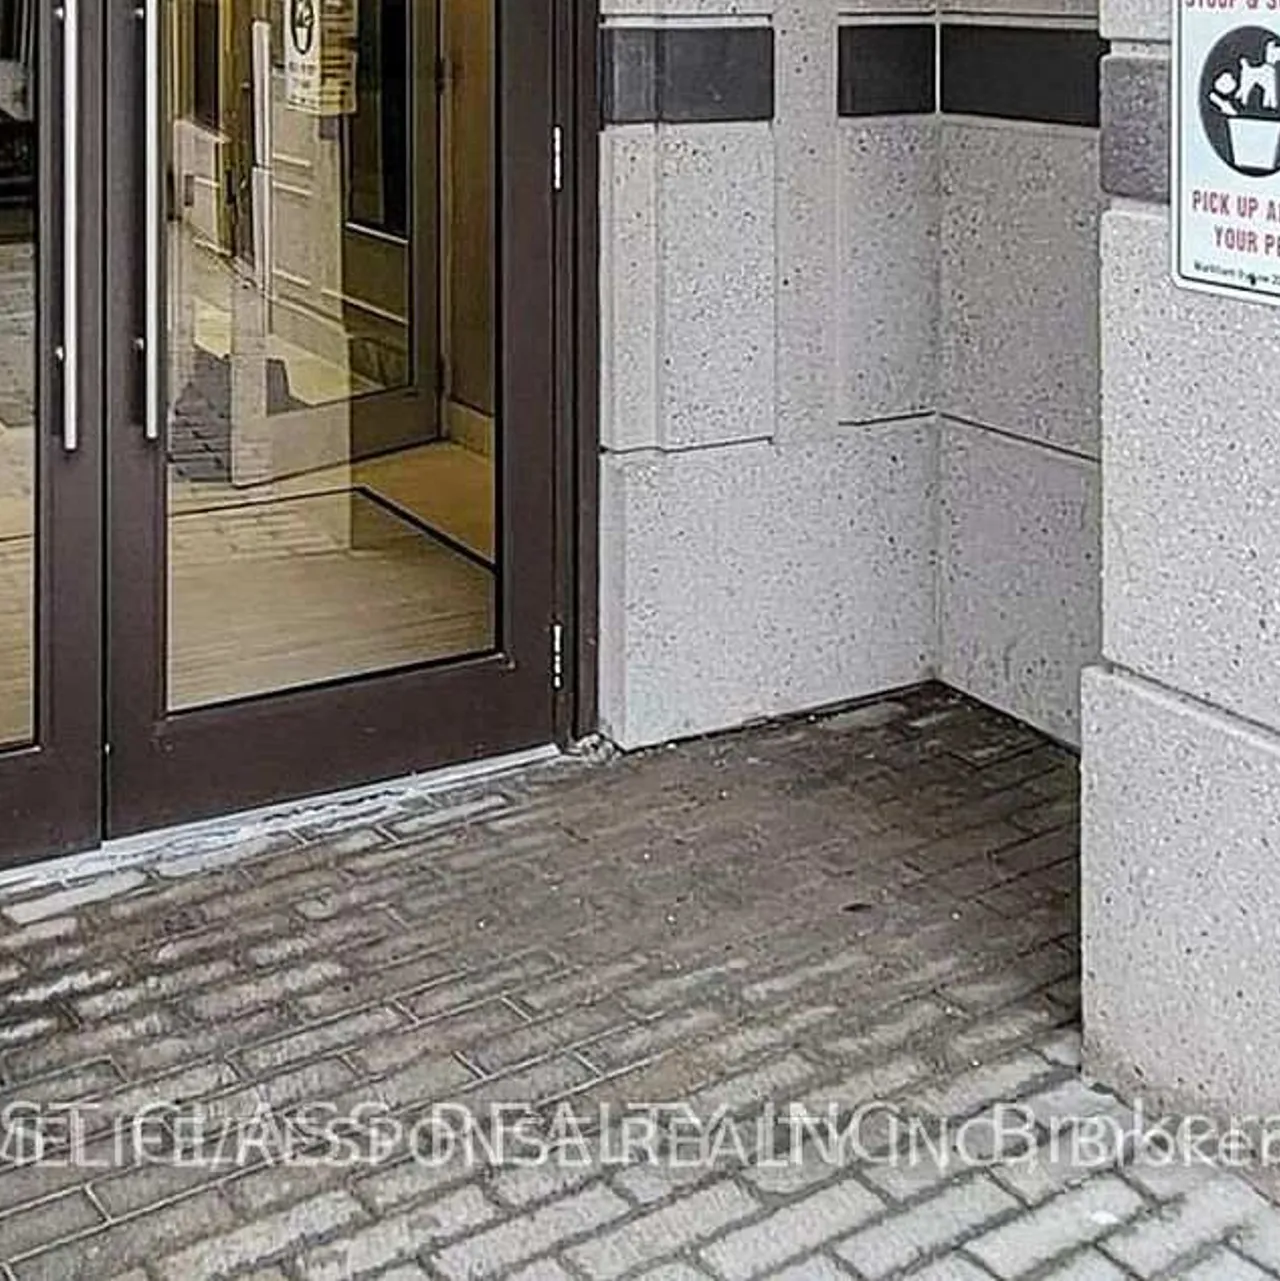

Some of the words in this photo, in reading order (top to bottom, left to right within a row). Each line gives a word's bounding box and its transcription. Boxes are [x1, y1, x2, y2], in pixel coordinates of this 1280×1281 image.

[1192, 189, 1230, 216] PICK
[1236, 195, 1259, 220] UP
[1214, 224, 1259, 254] YOUR
